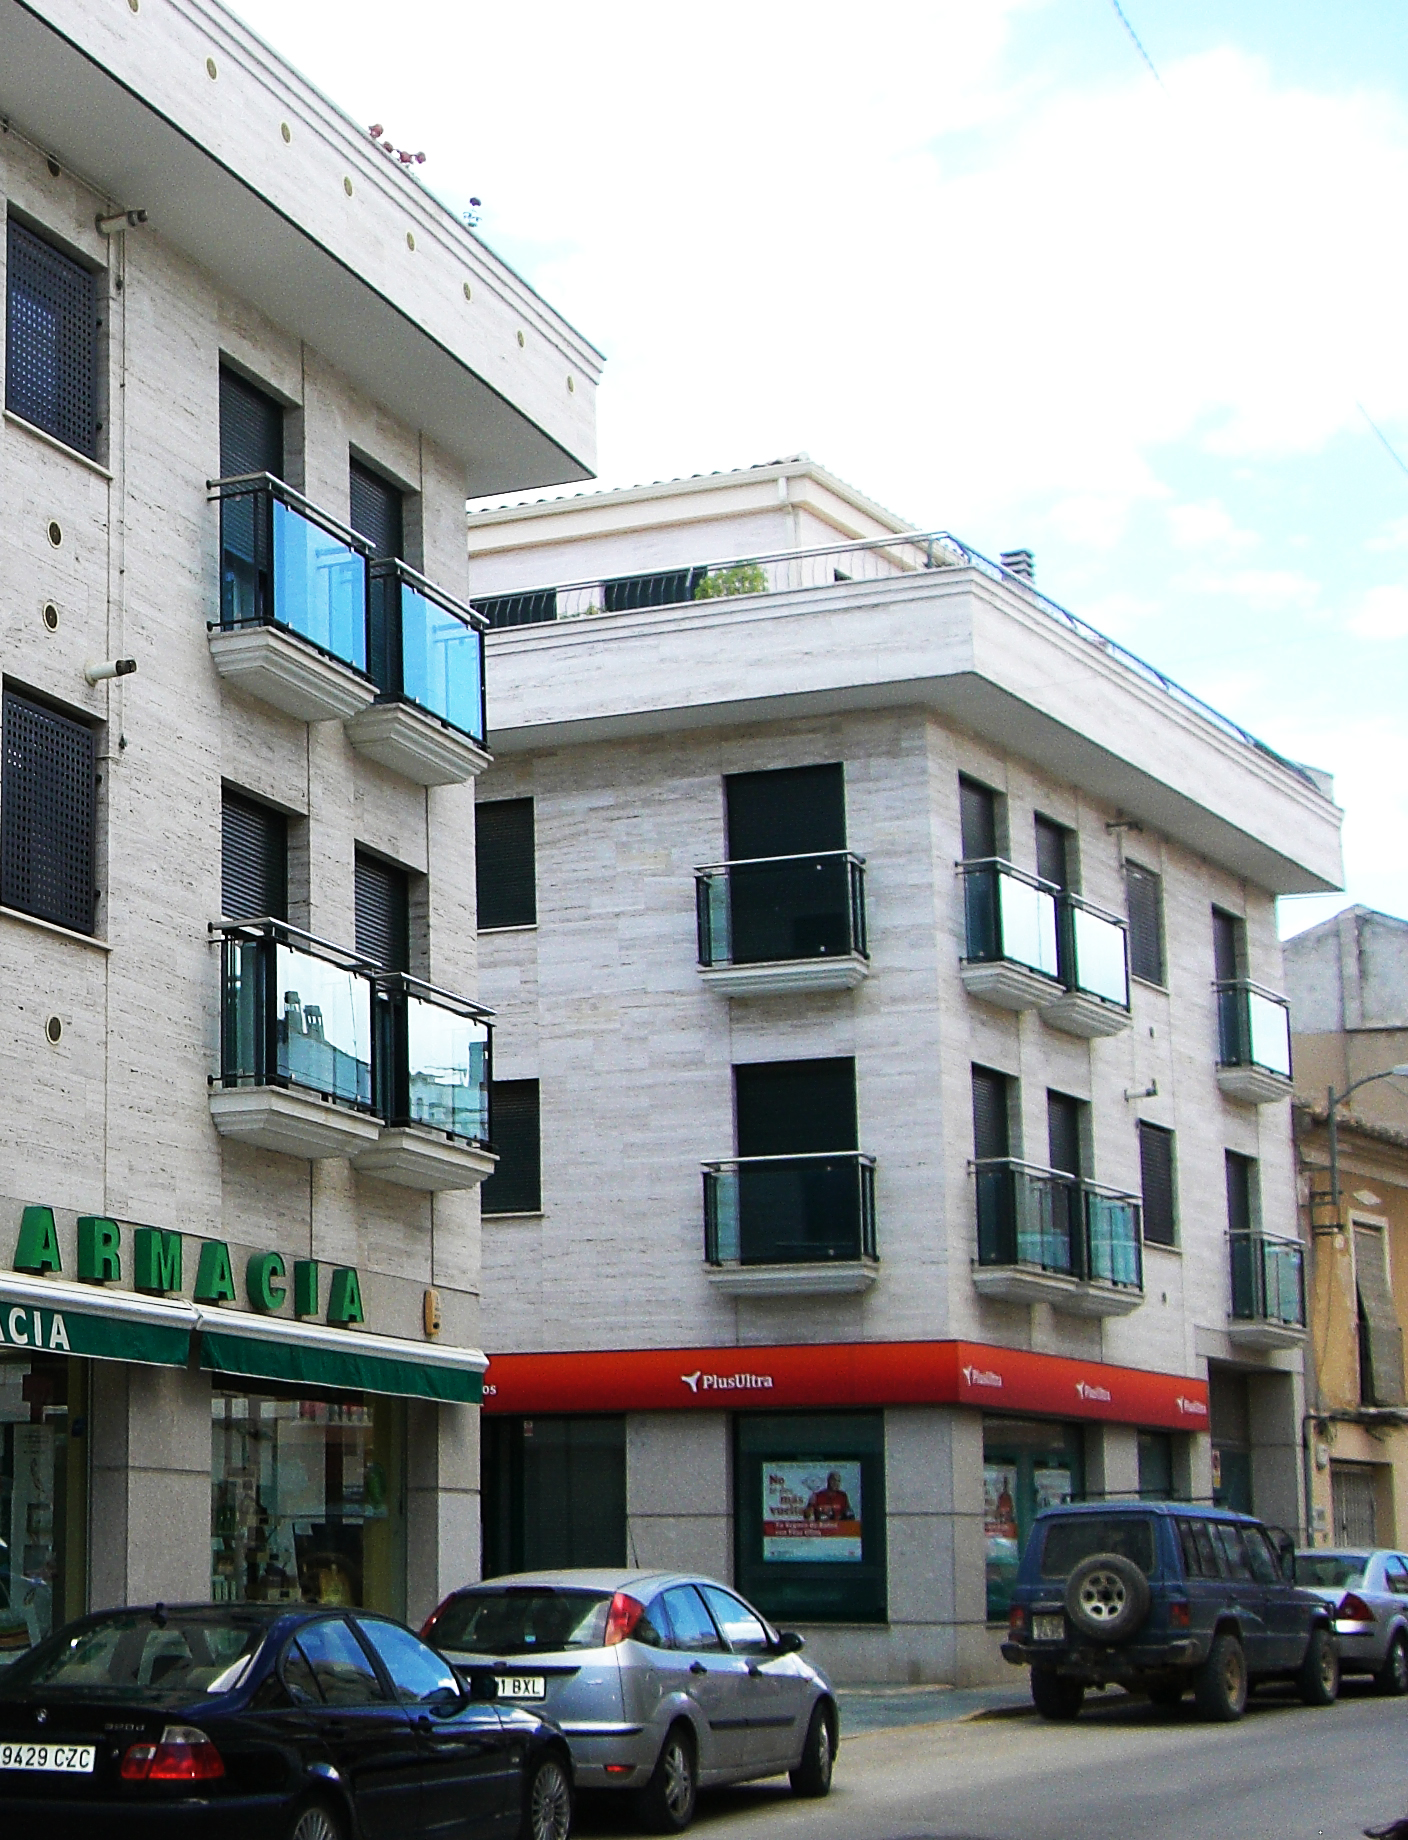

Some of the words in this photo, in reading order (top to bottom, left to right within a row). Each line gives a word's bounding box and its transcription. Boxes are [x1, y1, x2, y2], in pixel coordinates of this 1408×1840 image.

[703, 1374, 773, 1389] PlusUltra
[513, 1679, 541, 1694] BXL
[2, 1746, 48, 1767] 9429
[54, 1748, 91, 1768] CZC
